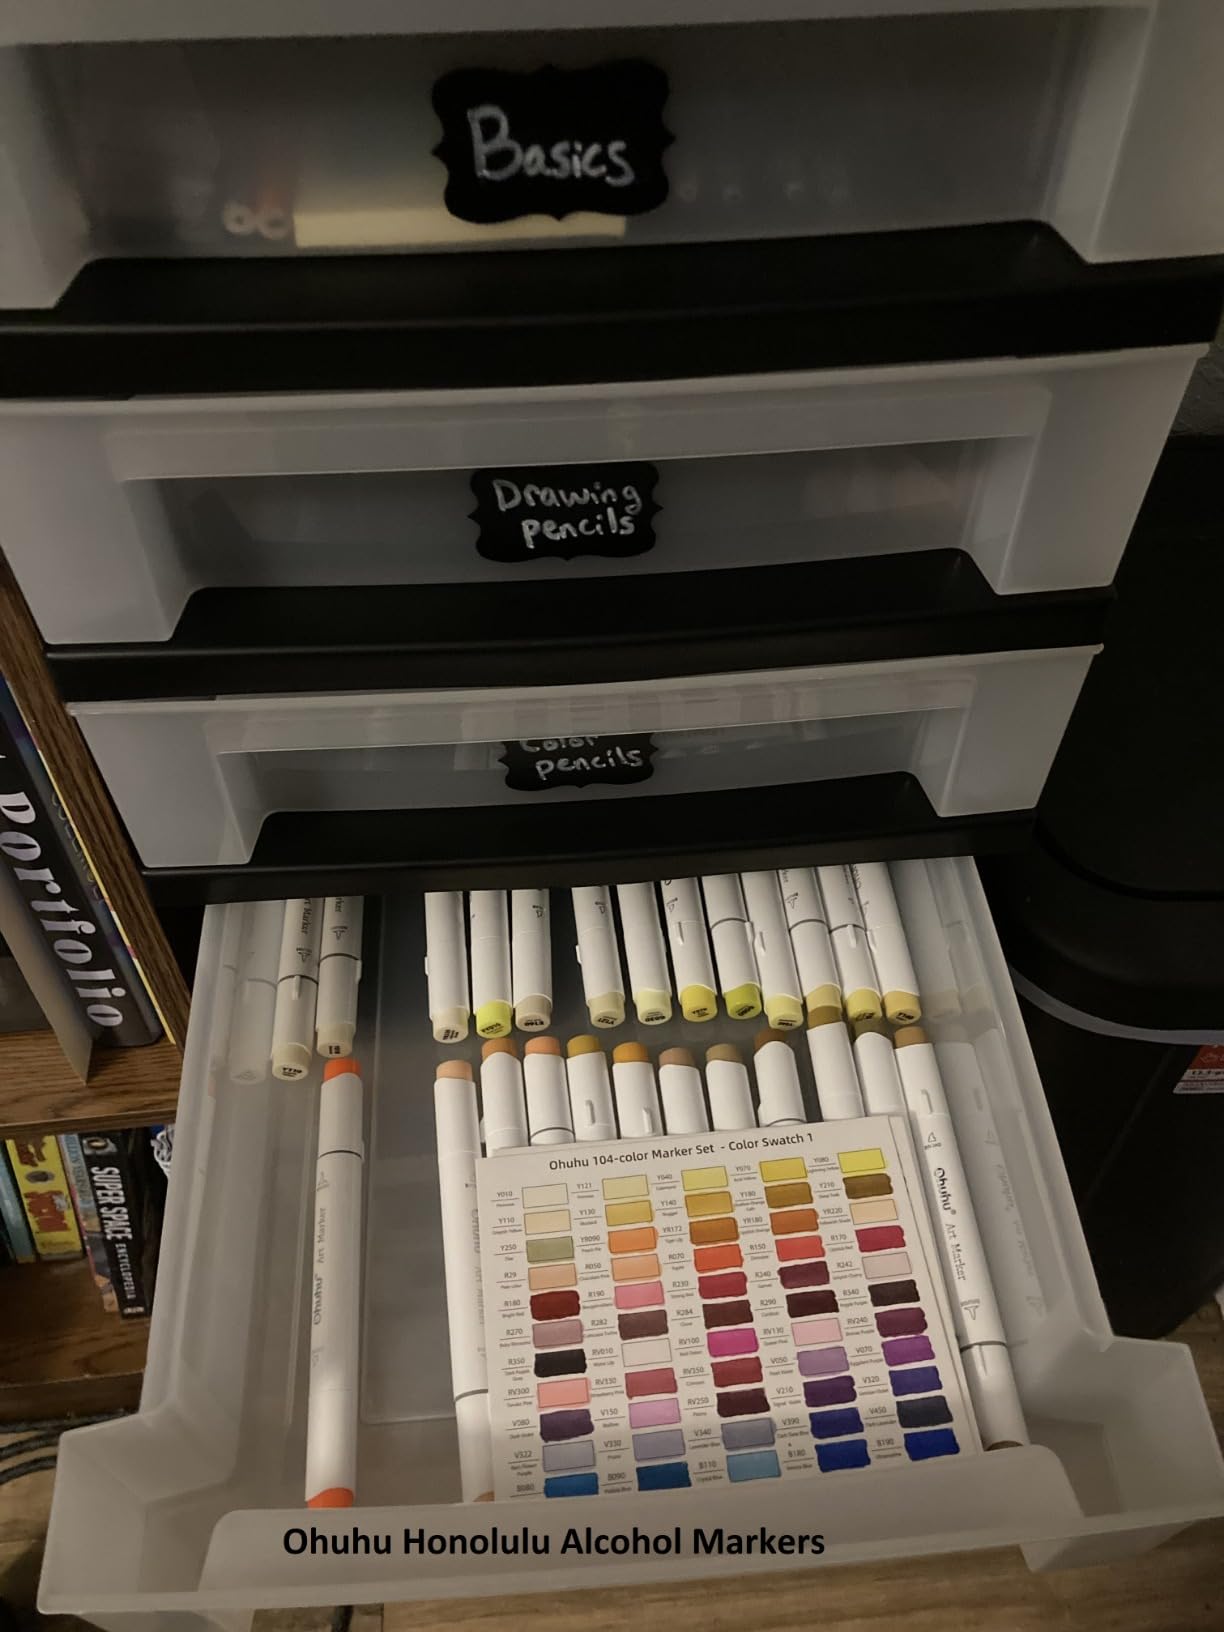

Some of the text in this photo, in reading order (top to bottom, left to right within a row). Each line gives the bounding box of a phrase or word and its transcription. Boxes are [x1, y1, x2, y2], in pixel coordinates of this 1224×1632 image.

[467, 104, 635, 187] Basics
[493, 479, 642, 515] Drawing
[521, 507, 636, 549] pencils
[536, 746, 643, 780] pencils
[549, 1159, 589, 1171] Ohuhu
[593, 1151, 648, 1166] 104-color
[652, 1146, 692, 1159] Marker
[696, 1144, 714, 1155] Set
[728, 1139, 758, 1151] Color
[762, 1133, 804, 1147] Swatch
[808, 1133, 813, 1142] 1
[90, 1166, 126, 1205] SUPER
[98, 1206, 134, 1241] SPACE
[317, 1207, 327, 1243] Marker
[944, 1223, 958, 1241] Art
[317, 1247, 325, 1264] Art
[950, 1243, 967, 1281] Marker
[600, 1408, 618, 1416] V150
